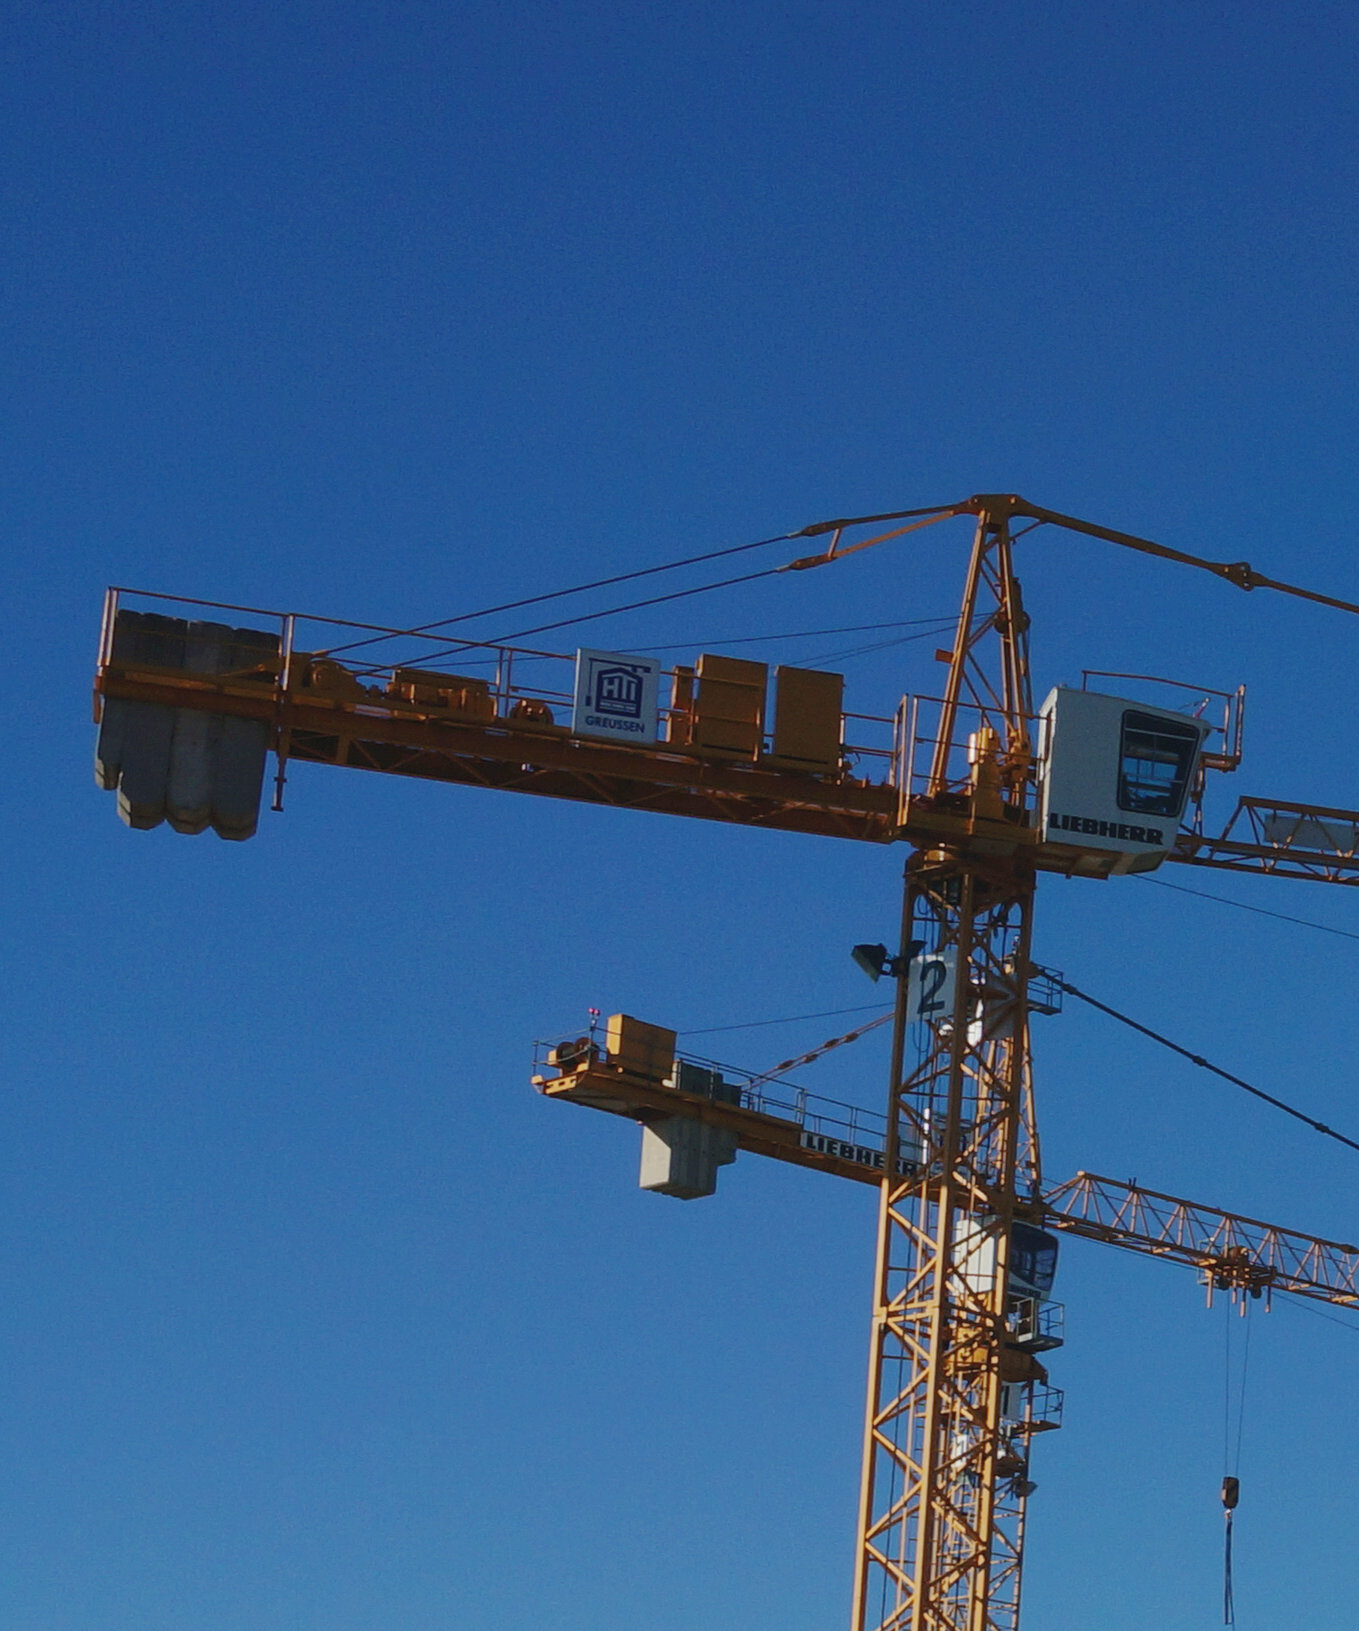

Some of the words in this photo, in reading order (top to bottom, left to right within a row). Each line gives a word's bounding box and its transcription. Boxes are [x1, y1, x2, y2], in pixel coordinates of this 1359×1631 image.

[585, 716, 645, 733] GREUSSEN
[1049, 812, 1164, 845] LIEBHERR
[917, 960, 947, 1014] 2
[806, 1133, 917, 1177] LIEBHER
